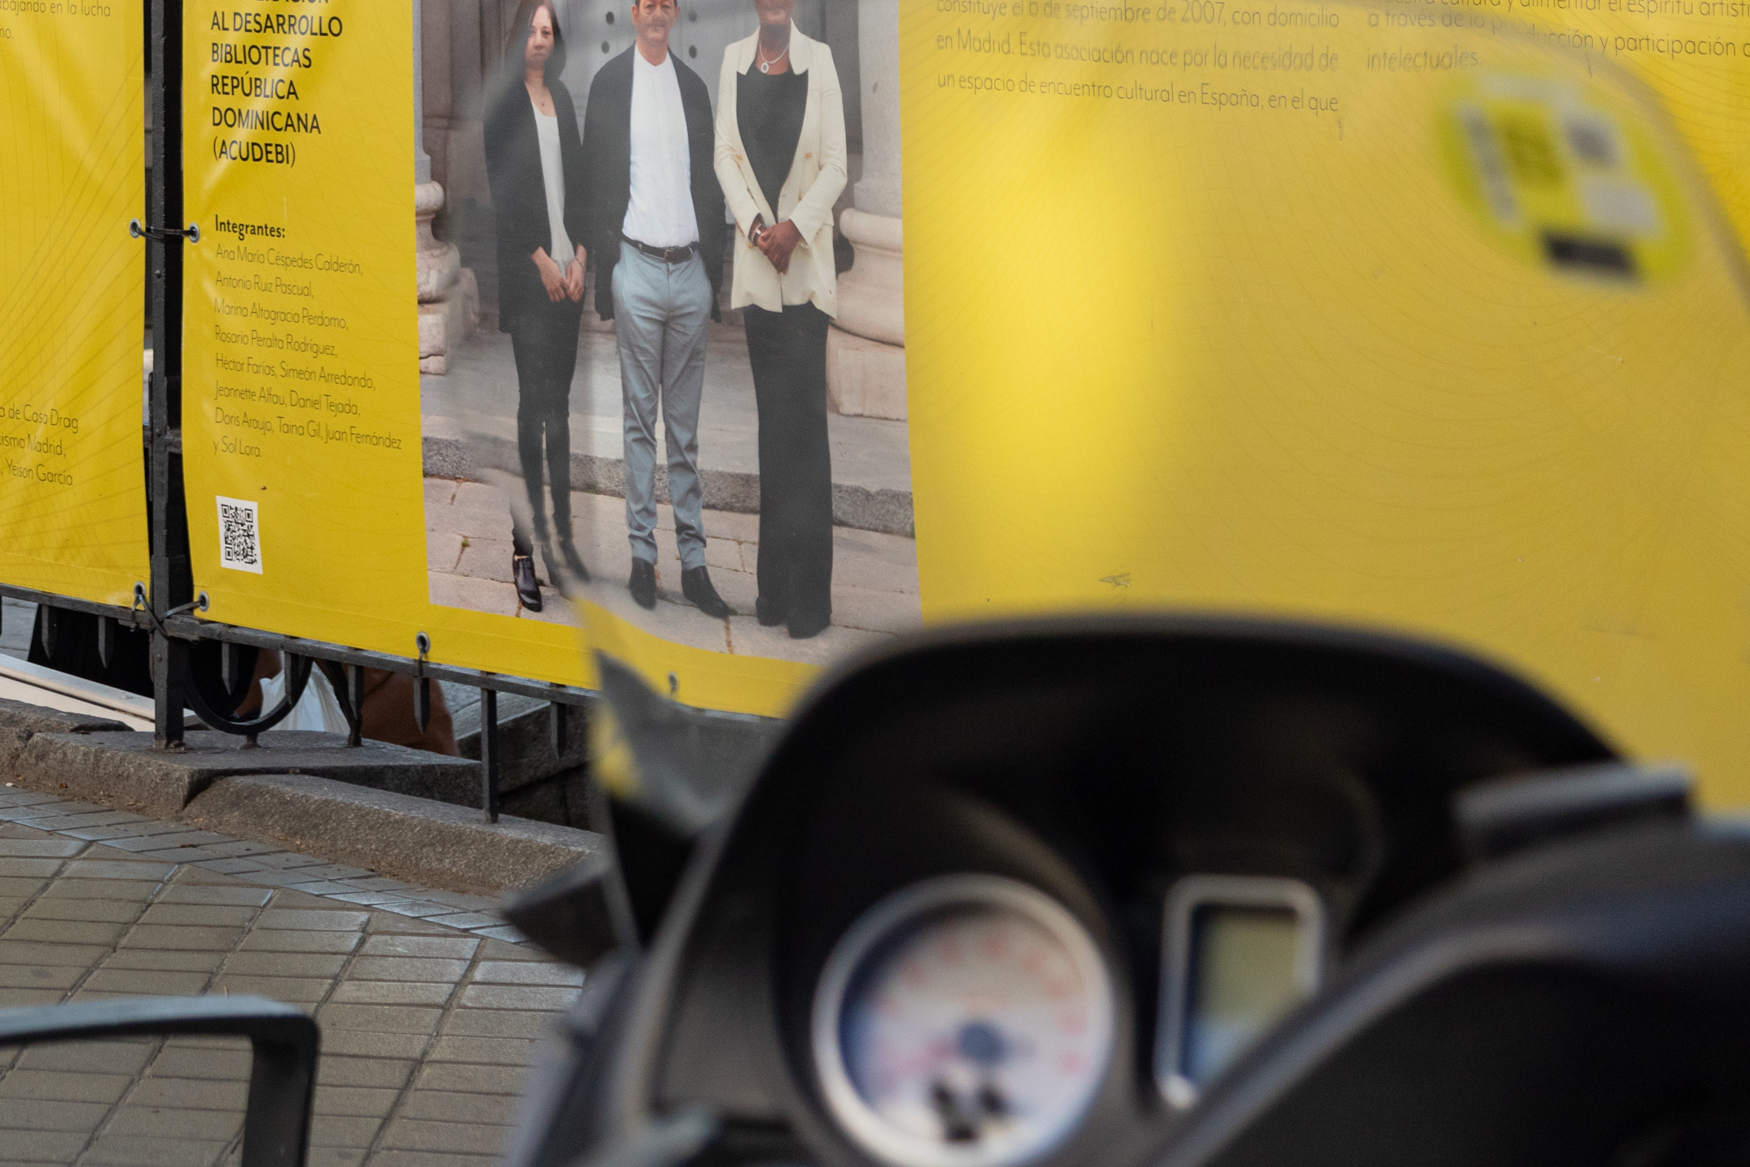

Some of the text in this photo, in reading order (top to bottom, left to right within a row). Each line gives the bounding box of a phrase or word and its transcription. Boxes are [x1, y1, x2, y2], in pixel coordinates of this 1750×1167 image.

[50, 2, 63, 14] en
[81, 0, 111, 17] lucha
[211, 11, 342, 37] AL DESARROLLO
[211, 43, 312, 68] BIBLIOTECAS
[211, 71, 299, 100] REPÚBLICA
[938, 69, 1339, 116] un espacio de encuentro cultural en España, en el que
[212, 107, 321, 134] DOMINICANA
[214, 136, 295, 167] (ACUDEBI)
[215, 215, 285, 241] Integrantes:
[216, 243, 363, 276] Ana María Céspedes Calderón,
[216, 353, 375, 390] Héctor Farías, Simeón Arredondo,
[8, 402, 20, 420] de
[23, 404, 47, 424] Casa
[51, 409, 78, 433] Drag
[215, 408, 240, 426] Doris
[307, 421, 323, 440] Gil,
[324, 427, 348, 444] Juan
[350, 429, 402, 450] Fernández
[28, 435, 66, 457] Madrid,
